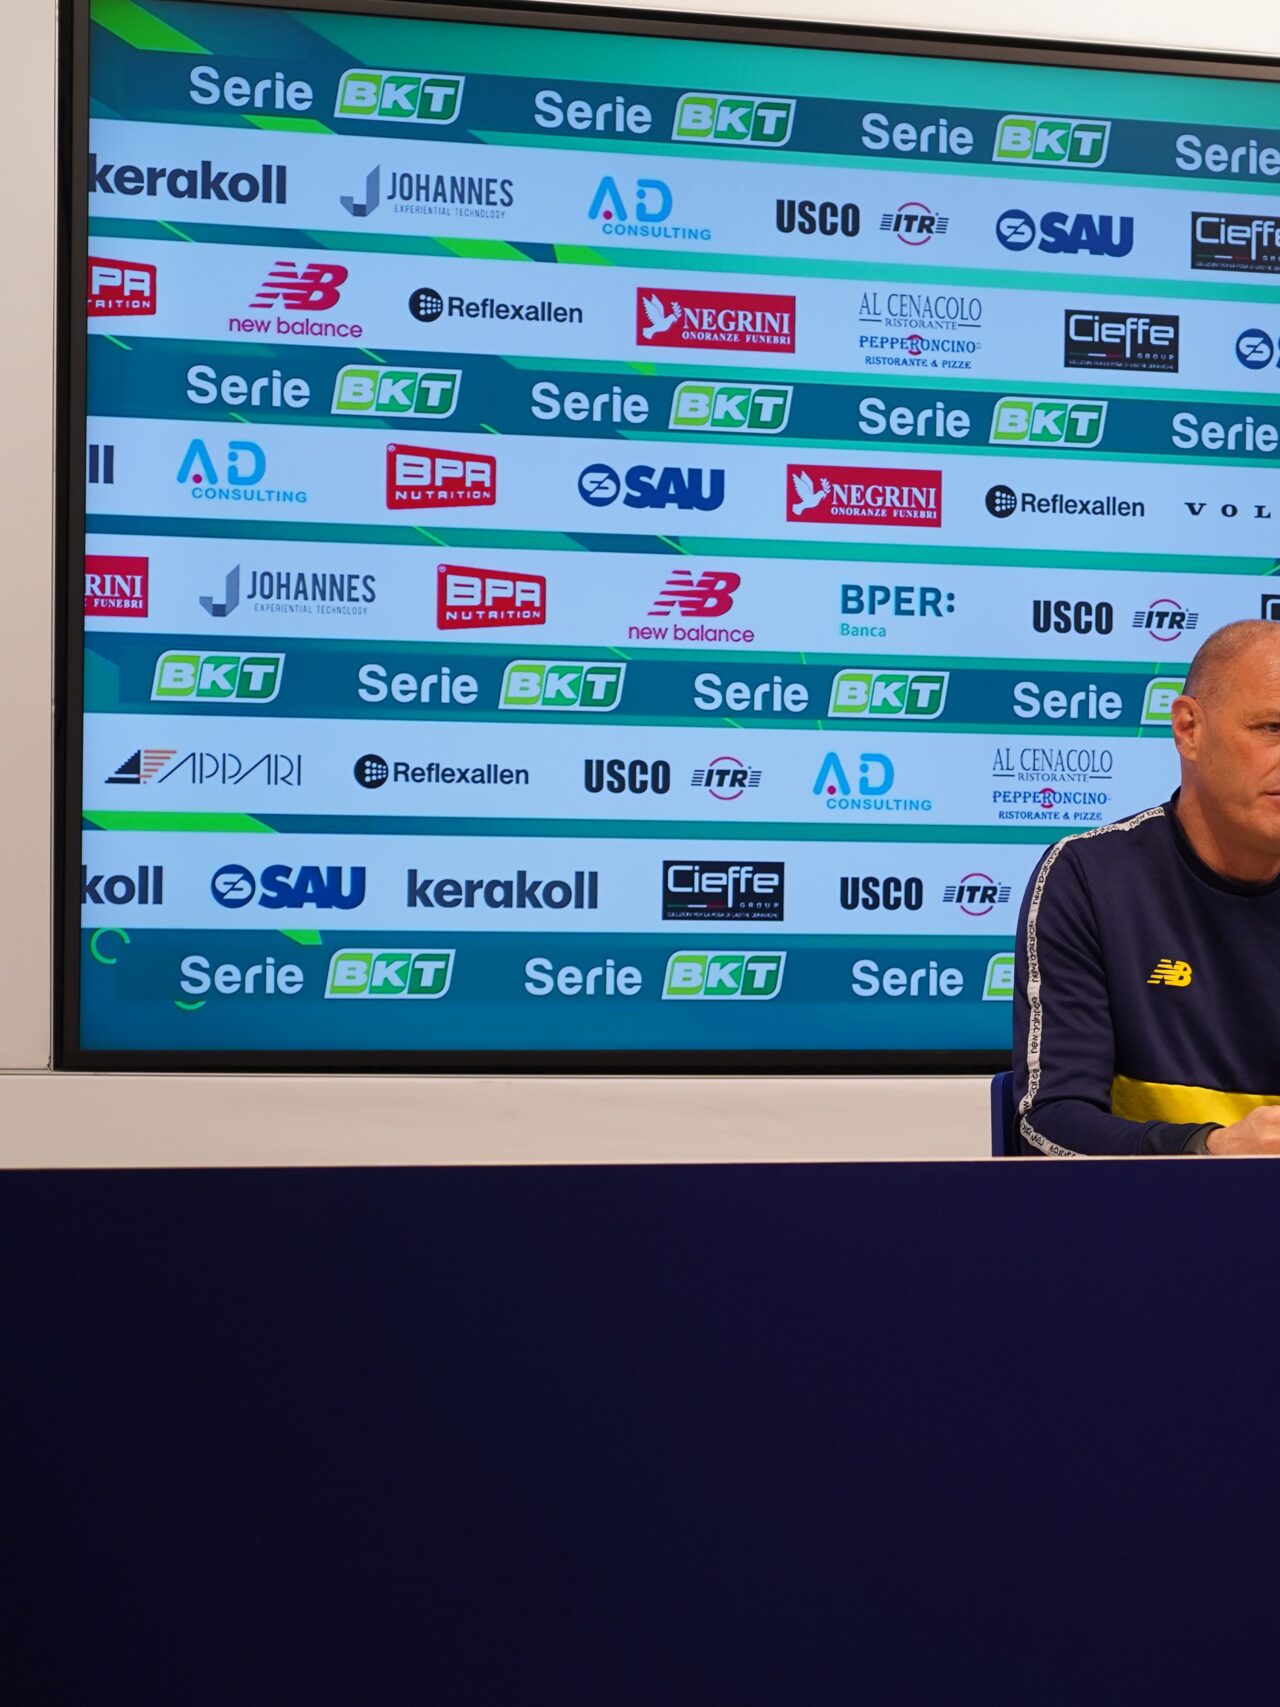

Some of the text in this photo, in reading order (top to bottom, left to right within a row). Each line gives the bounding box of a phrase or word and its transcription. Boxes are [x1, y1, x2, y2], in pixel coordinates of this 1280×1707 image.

[190, 66, 459, 117] Serie BKT
[535, 90, 790, 141] Serie BKT
[862, 113, 1104, 162] Serie BKT
[89, 153, 286, 204] kerakoll
[387, 173, 513, 207] JOHANNES
[603, 224, 711, 240] CONSULTING
[777, 200, 859, 237] USCO
[893, 215, 935, 233] ITR
[1038, 212, 1133, 257] SAU
[92, 266, 150, 297] PA
[88, 299, 150, 308] RITION
[448, 297, 582, 323] Reflexallen
[859, 292, 982, 321] AL CENACOLO
[230, 317, 362, 337] new balance
[682, 308, 789, 336] NEGRINI
[885, 317, 958, 330] RISTORANTE
[1070, 315, 1174, 359] Cieffe
[682, 331, 790, 344] ONORANZE FUNEBRI
[860, 336, 976, 353] PEPPERONCINO
[865, 356, 972, 369] RISTORANTE & PIZZE
[187, 365, 456, 413] Serie BKT
[532, 382, 788, 428] Serie BKT
[859, 398, 1102, 442] Serie BKT
[1172, 413, 1278, 451] Serie
[396, 454, 490, 487] BPA
[192, 487, 307, 503] CONSULTING
[396, 491, 490, 499] NUTRITION
[623, 465, 724, 511] SAU
[832, 484, 936, 508] NEGRINI
[831, 507, 936, 518] ONORANZE FUNEBRI
[1022, 493, 1144, 516] Reflexallen
[85, 573, 143, 598] RINI
[247, 571, 375, 602] JOHANNES
[447, 575, 540, 607] BPA
[842, 585, 954, 616] BPER:
[94, 598, 143, 608] FUNEBRI
[446, 611, 540, 620] NUTRITION
[1033, 600, 1113, 634] USCO
[629, 624, 754, 642] new balance
[840, 623, 886, 637] Banca
[1143, 610, 1184, 629] ITR
[160, 660, 278, 698] BKT
[358, 664, 619, 708] Serie BKT
[694, 673, 943, 715] Serie BKT
[1014, 682, 1122, 719] Serie
[394, 762, 528, 784] Reflexallen
[993, 748, 1113, 773] AL CENACOLO
[585, 759, 670, 794] USCO
[704, 769, 748, 788] ITR
[1018, 773, 1090, 782] RISTORANTE
[827, 799, 931, 811] CONSULTING
[993, 790, 1107, 805] PEPPERONCINO
[999, 811, 1102, 821] RISTORANTE & PIZZE
[81, 864, 163, 905] koll
[258, 865, 365, 909] SAU
[407, 869, 598, 909] kerakoll
[668, 866, 778, 907] Cieffe
[840, 877, 923, 910] USCO
[955, 885, 998, 904] ITR
[1032, 884, 1043, 905] new
[181, 956, 449, 994] Serie BKT
[525, 958, 780, 995] Serie BKT
[852, 960, 963, 996] Serie
[1031, 1034, 1039, 1054] new
